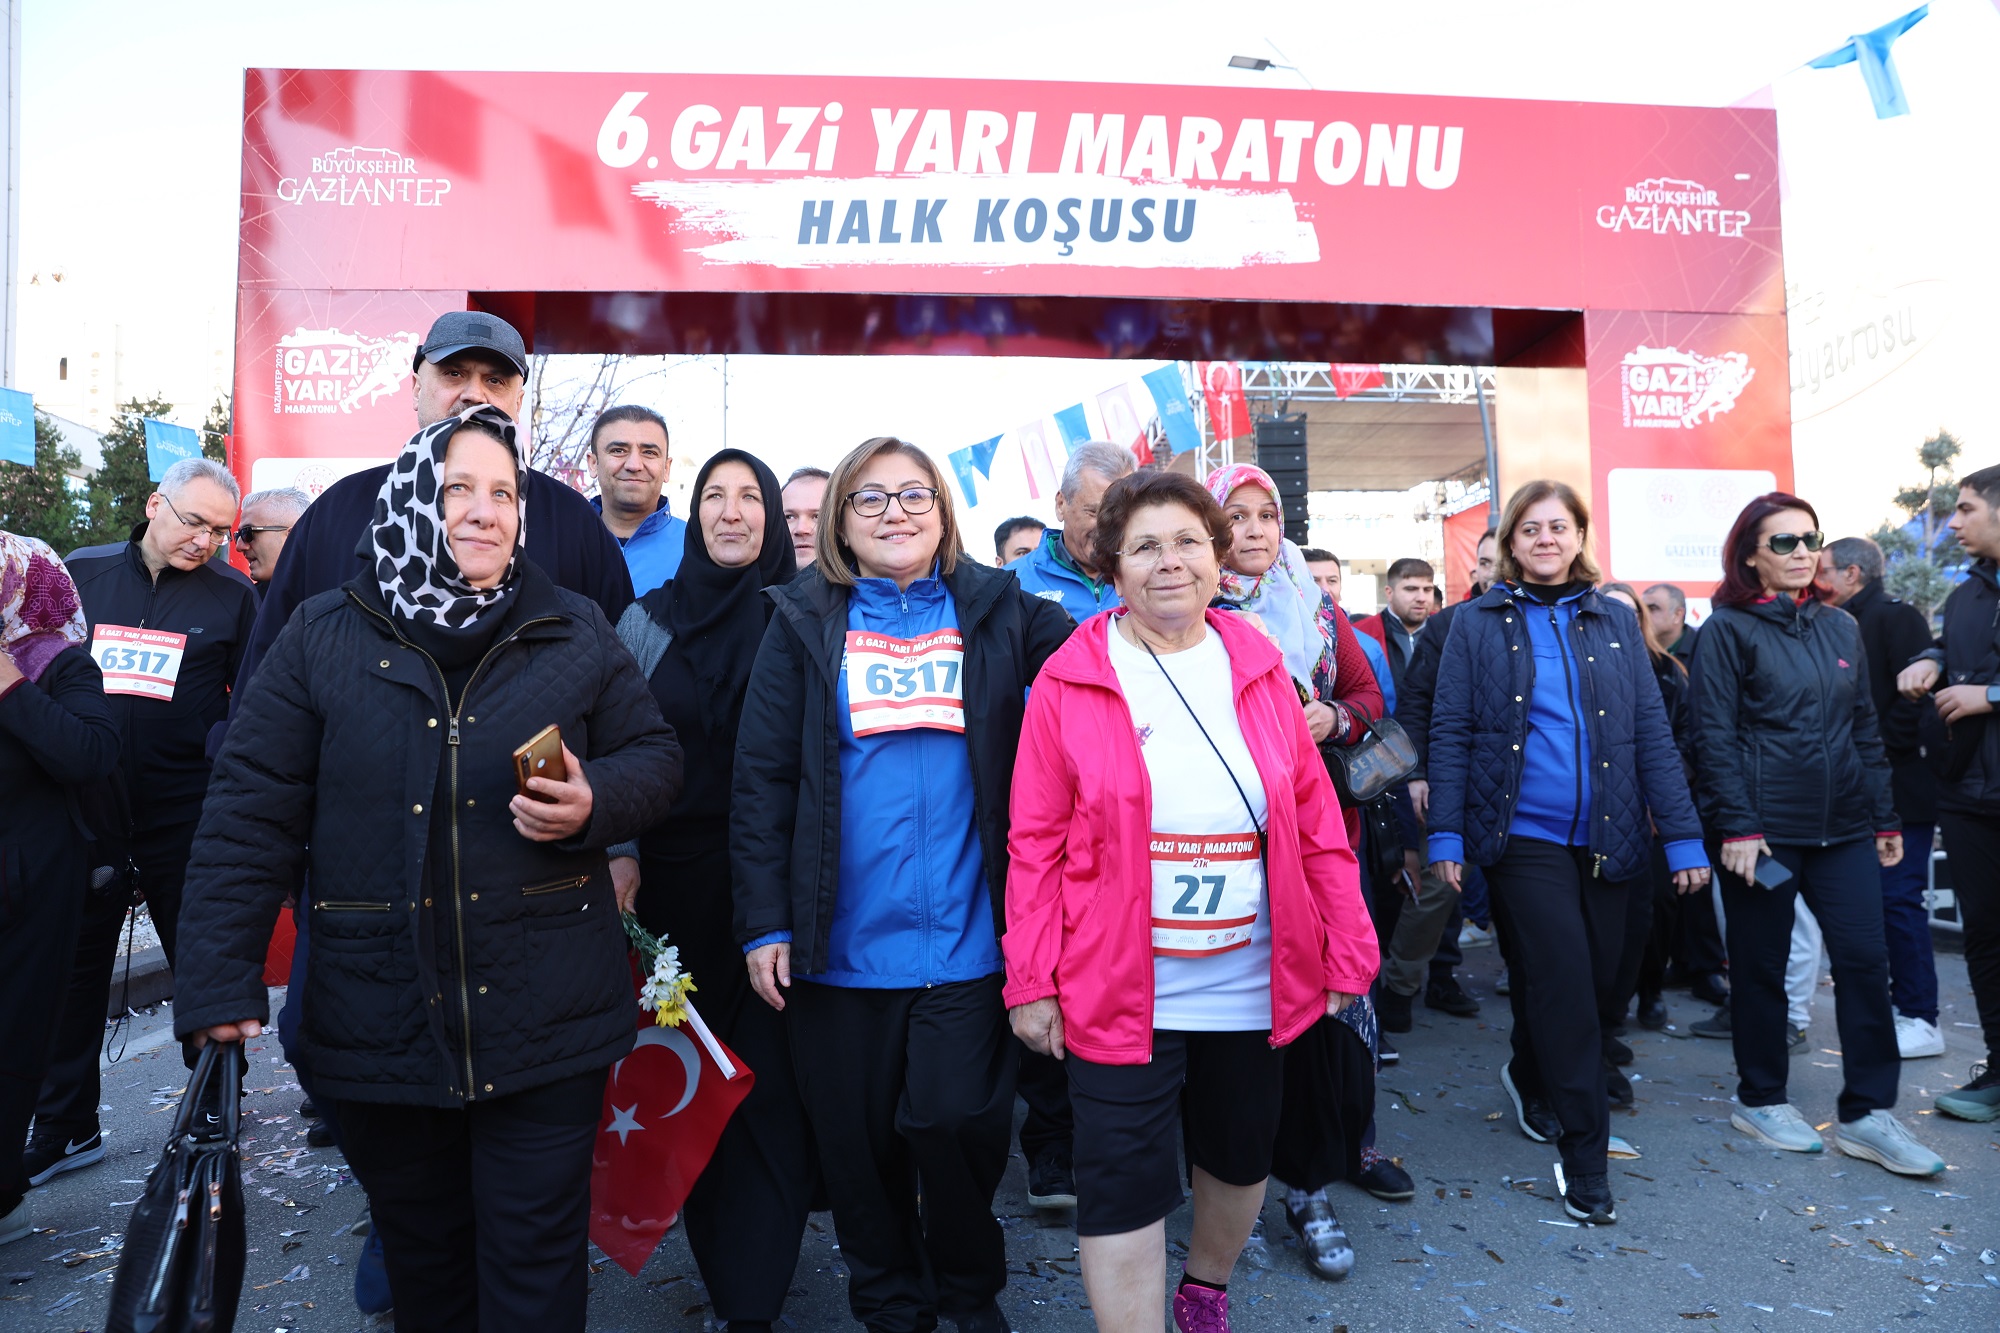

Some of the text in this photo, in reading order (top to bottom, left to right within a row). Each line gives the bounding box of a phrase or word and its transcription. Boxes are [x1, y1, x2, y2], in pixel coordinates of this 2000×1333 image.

[871, 107, 1037, 174] YARI
[1058, 112, 1464, 190] MARATONU
[312, 157, 418, 176] BÜYÜKŞEHİR
[277, 175, 451, 206] GAZİANTEP
[798, 198, 1196, 256] HALK KOŞUSU
[1596, 203, 1751, 237] GAZİANTEP
[284, 379, 341, 401] YARI
[285, 405, 337, 414] MARATONU
[1630, 395, 1683, 417] YARI
[141, 633, 181, 645] MARATONU
[889, 643, 910, 654] YARI
[913, 635, 963, 653] MARATONU
[100, 647, 170, 675] 6317
[904, 656, 918, 664] 21K
[865, 660, 959, 698] 6317
[1177, 842, 1202, 854] YARI
[1203, 840, 1253, 854] MARATONU
[1193, 859, 1209, 868] 21K
[1172, 874, 1226, 915] 27
